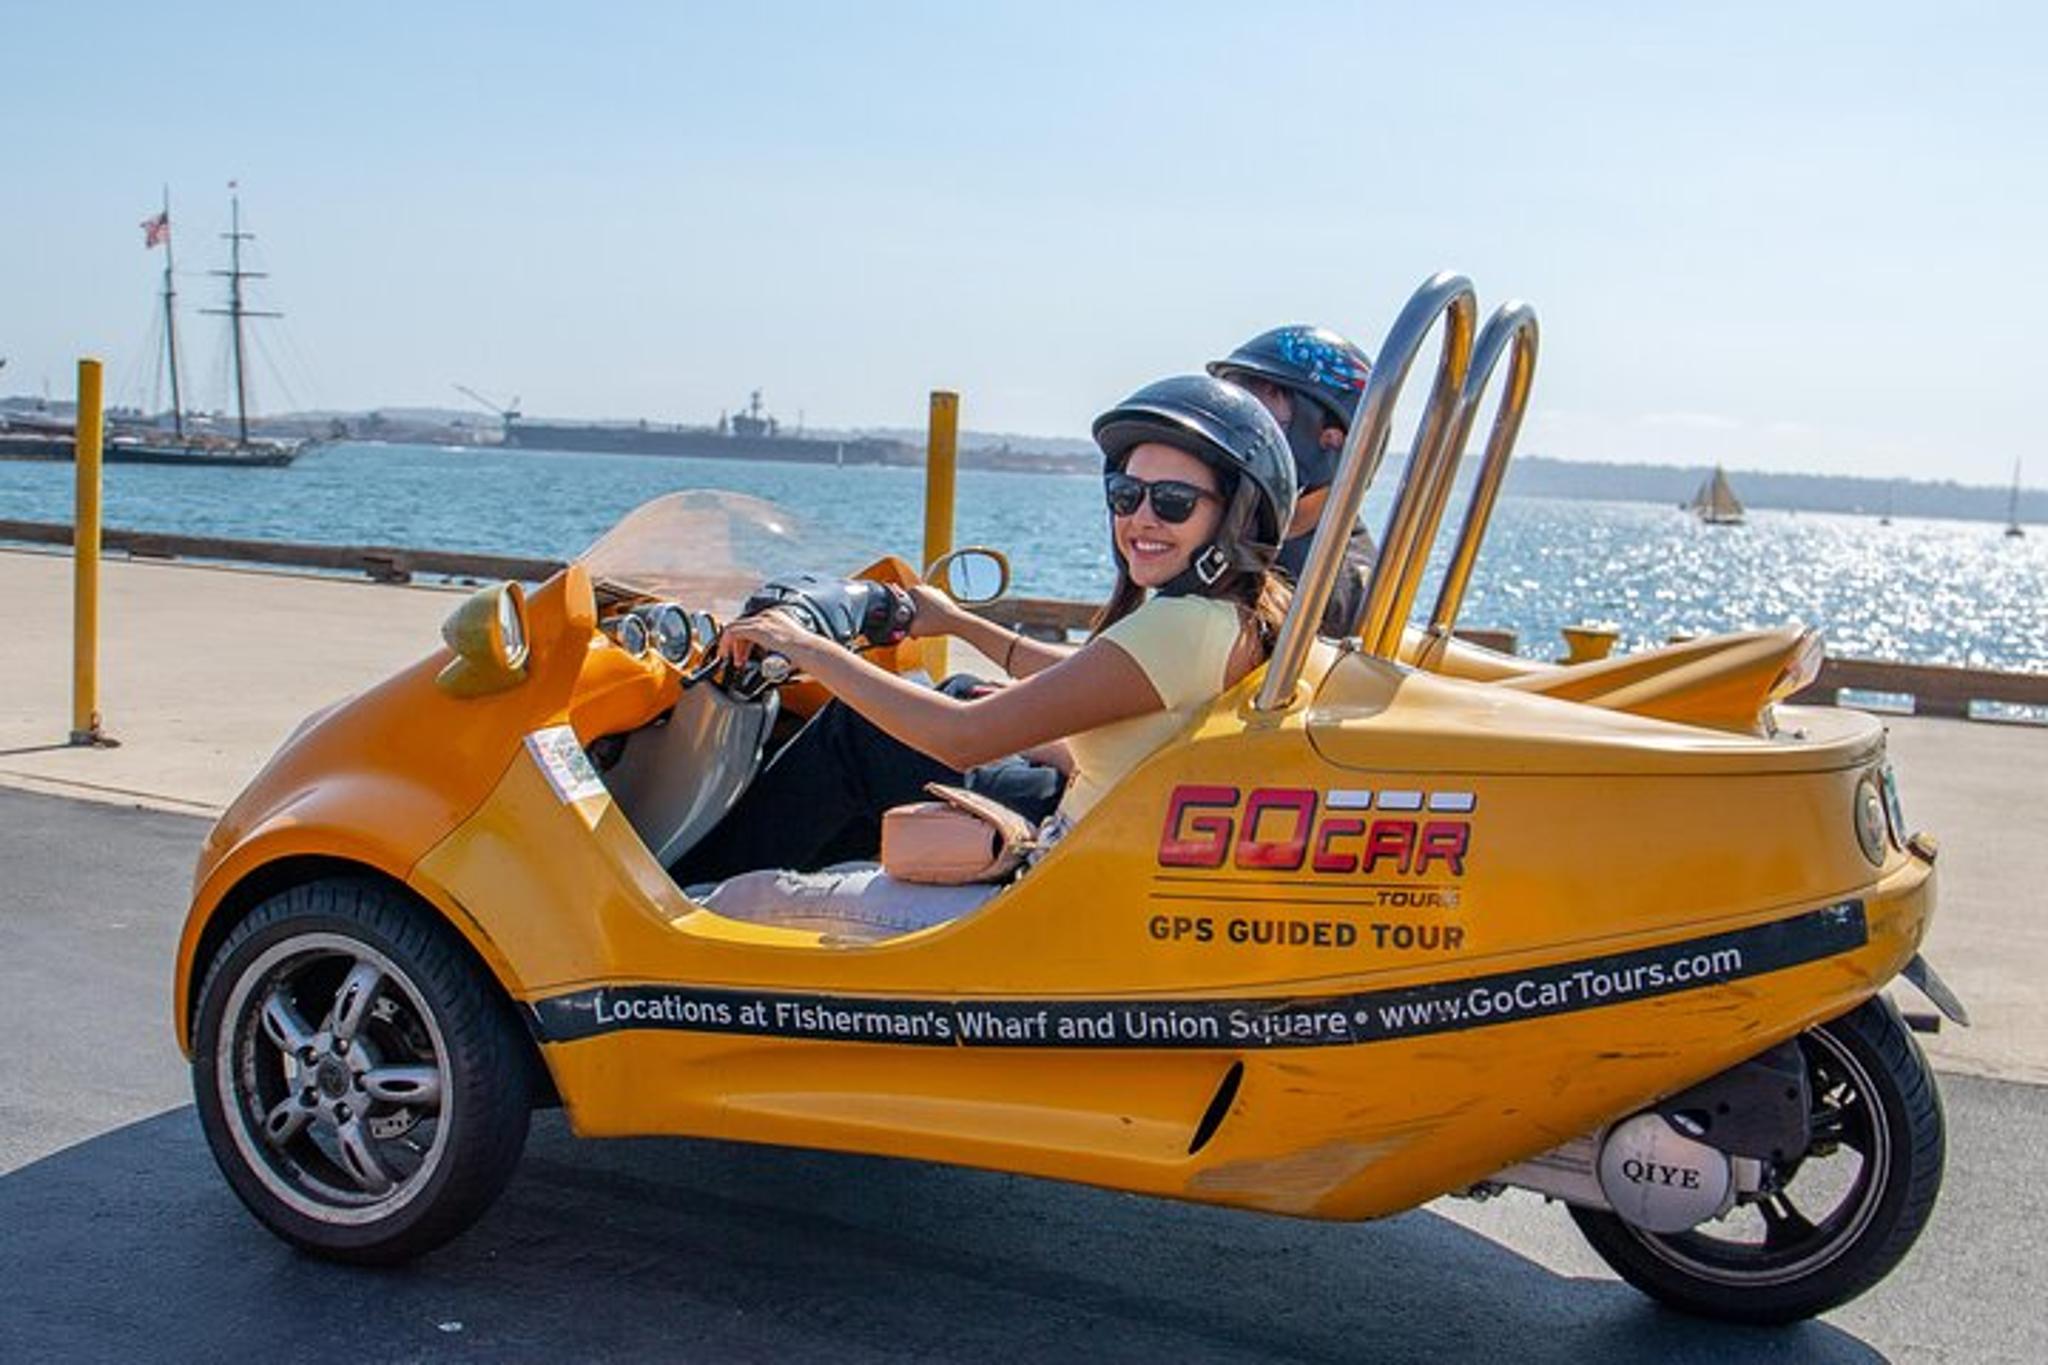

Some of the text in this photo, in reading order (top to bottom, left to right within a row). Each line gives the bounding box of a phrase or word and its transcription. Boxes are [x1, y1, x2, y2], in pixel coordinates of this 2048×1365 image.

[1377, 891, 1460, 908] TOUR
[1149, 916, 1465, 950] GPS GUIDED TOUR
[594, 945, 1742, 1044] Locations at Fisherman's Wharf and Union Square www.GoCarTours.com
[1623, 1159, 1699, 1190] QIYE
